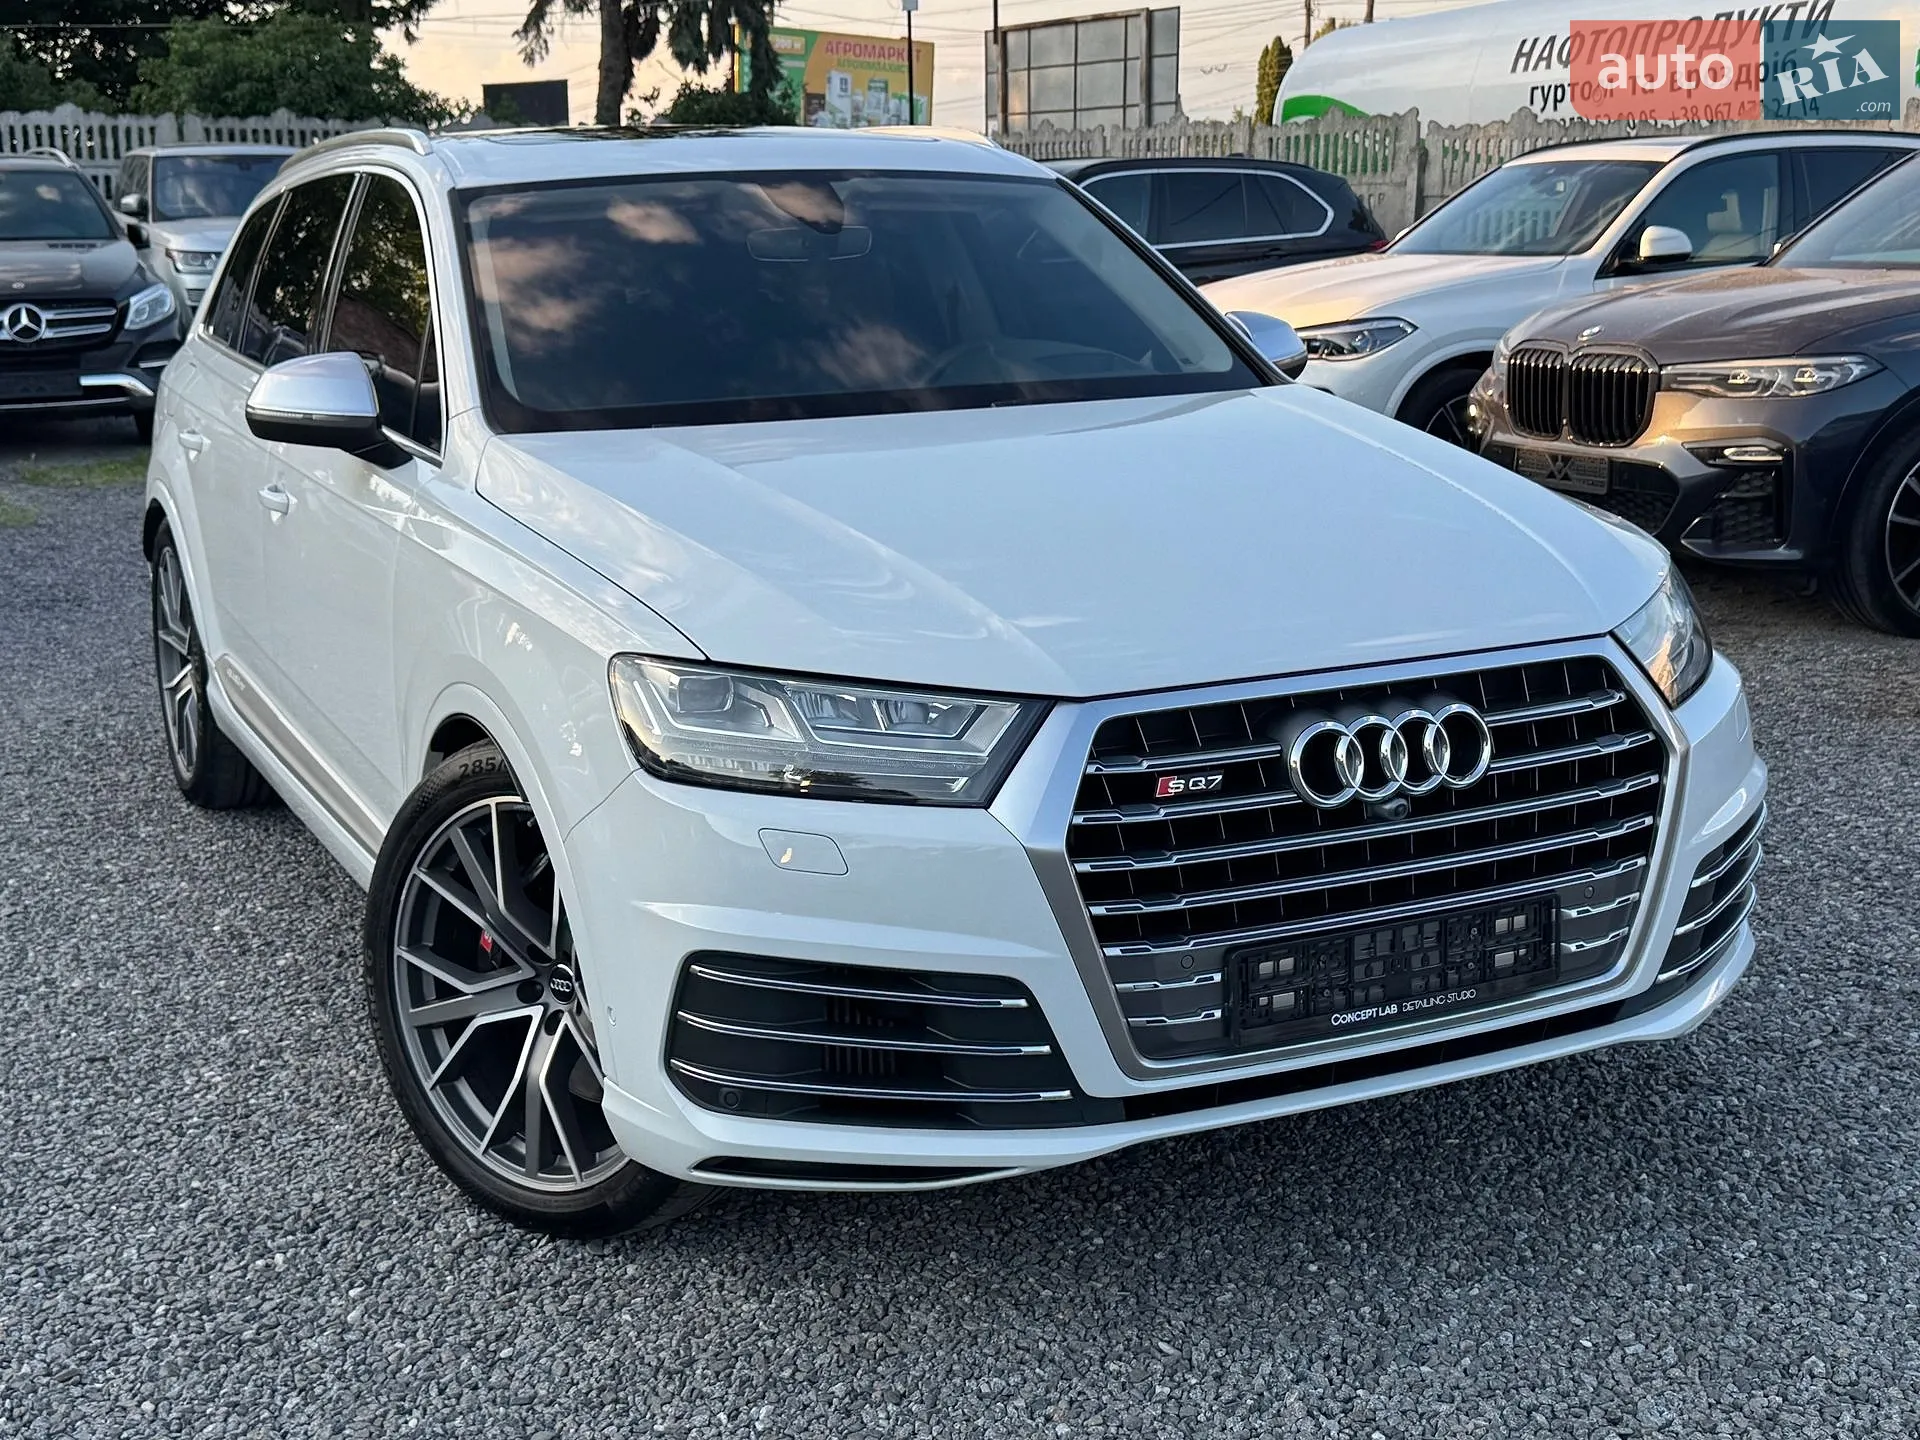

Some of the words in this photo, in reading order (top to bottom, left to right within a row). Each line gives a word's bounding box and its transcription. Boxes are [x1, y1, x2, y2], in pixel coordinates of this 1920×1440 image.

[1510, 0, 1836, 74] НАФТОПРОДУКТИ
[825, 39, 922, 63] АГРОМАРКТ
[1379, 1003, 1398, 1016] LAB
